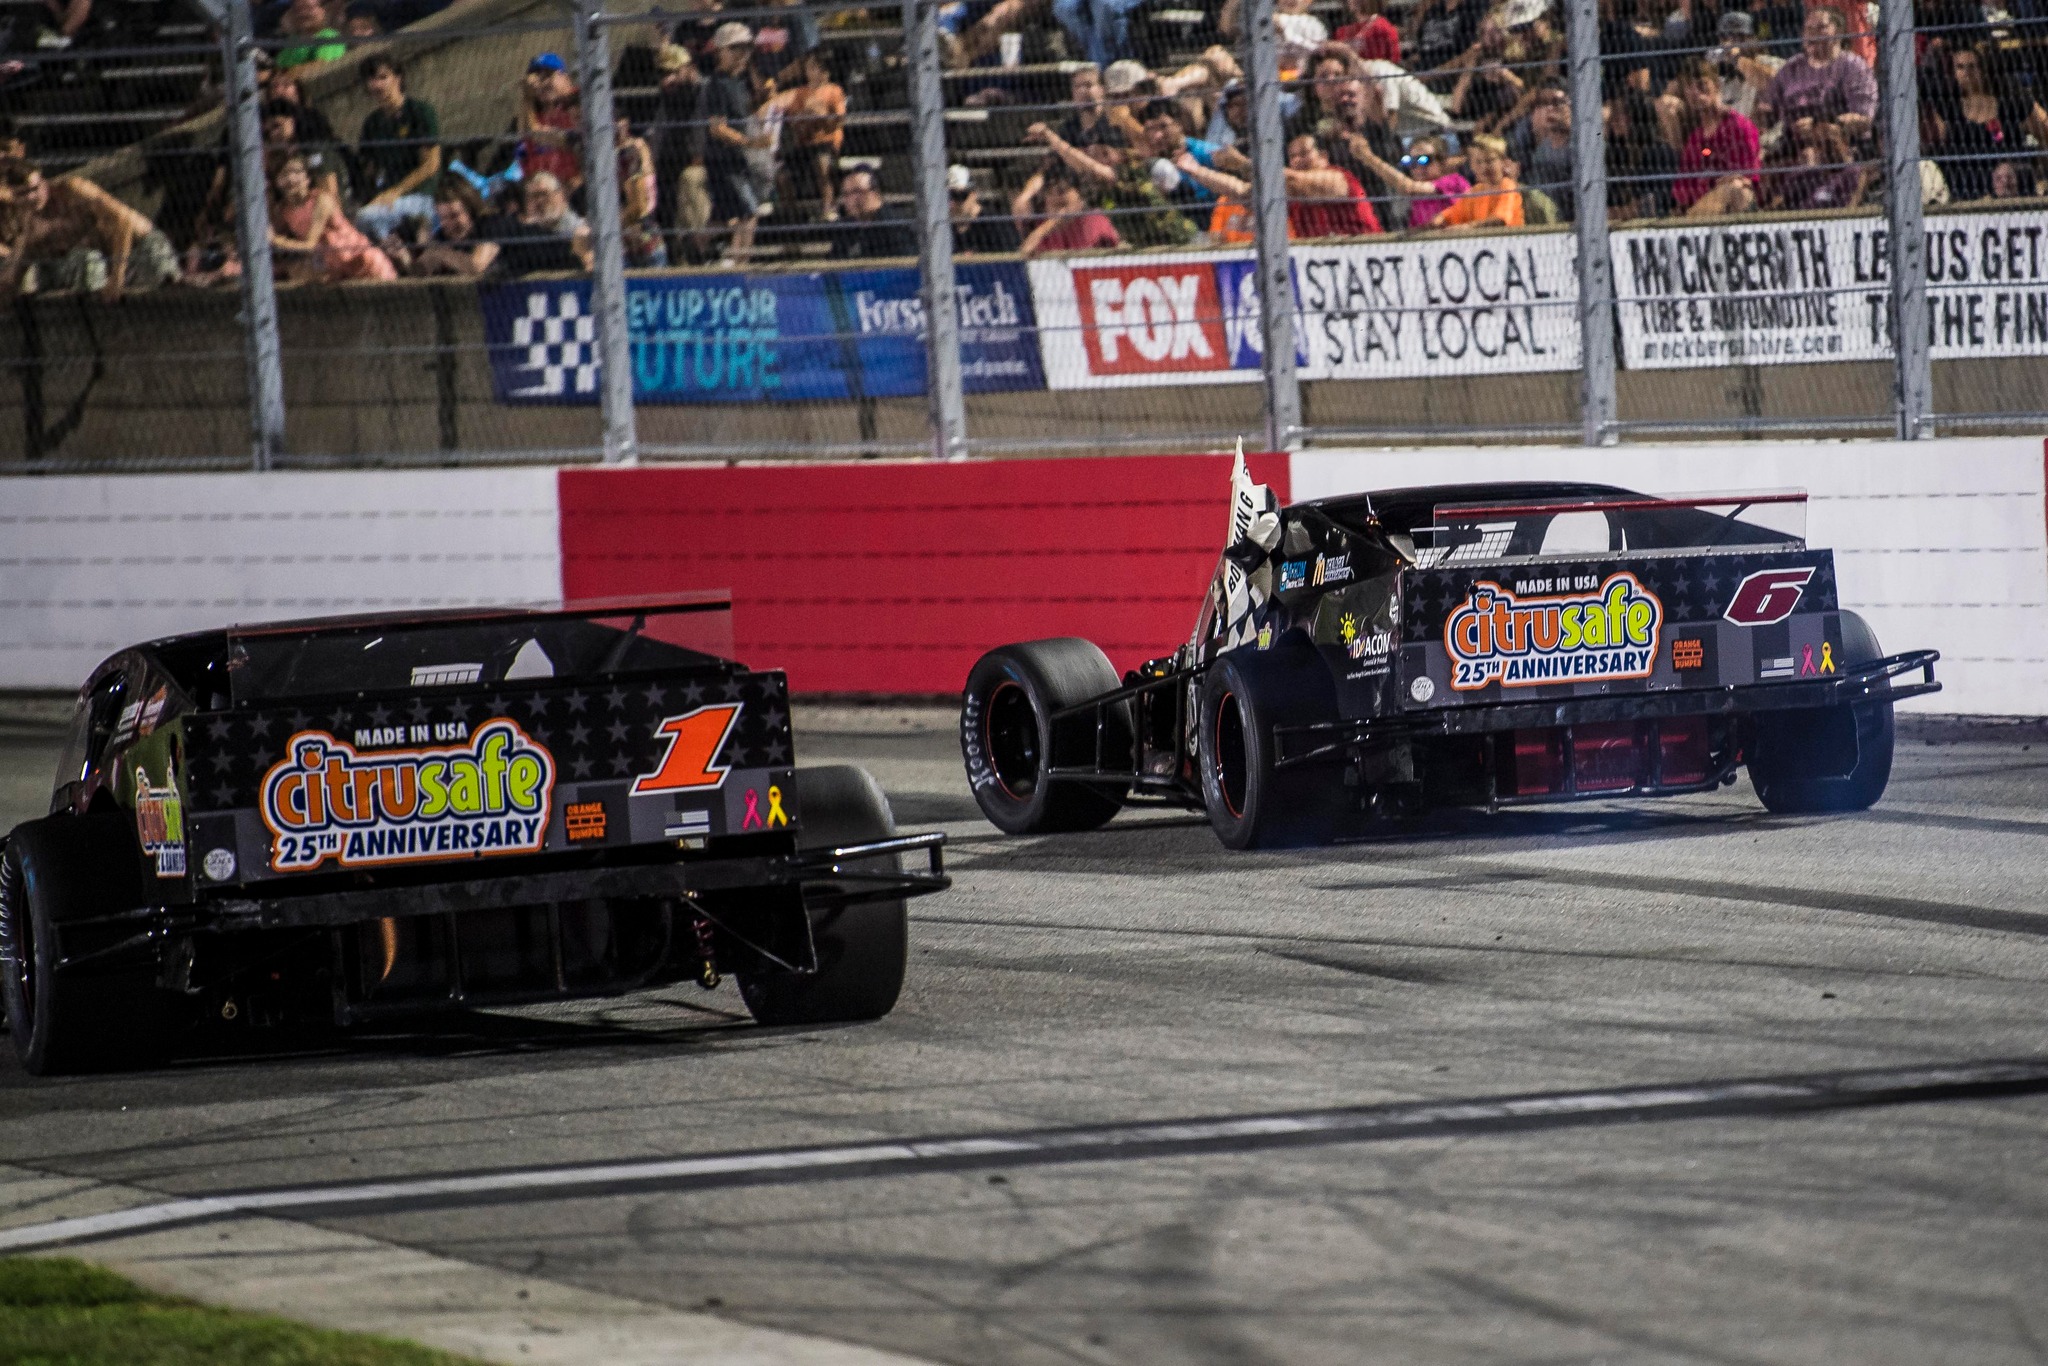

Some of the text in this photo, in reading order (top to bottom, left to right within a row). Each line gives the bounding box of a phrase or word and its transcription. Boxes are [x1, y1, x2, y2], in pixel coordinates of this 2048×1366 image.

[1305, 247, 1561, 310] START LOCAL.
[1853, 226, 2042, 282] LE US GET
[666, 288, 703, 328] UP
[956, 280, 1019, 327] Tech
[1089, 274, 1214, 364] FOX
[1926, 293, 1985, 346] THE
[629, 328, 782, 391] UTURE
[1323, 307, 1559, 366] STAY LOCAL.
[1515, 575, 1599, 594] MADE IN USA
[1723, 566, 1816, 626] 6
[1457, 650, 1650, 684] 25TH ANNIVERSARY
[354, 721, 469, 747] MADE IN USA
[629, 702, 744, 796] 1
[280, 817, 541, 864] 25TH ANNIVERSARY
